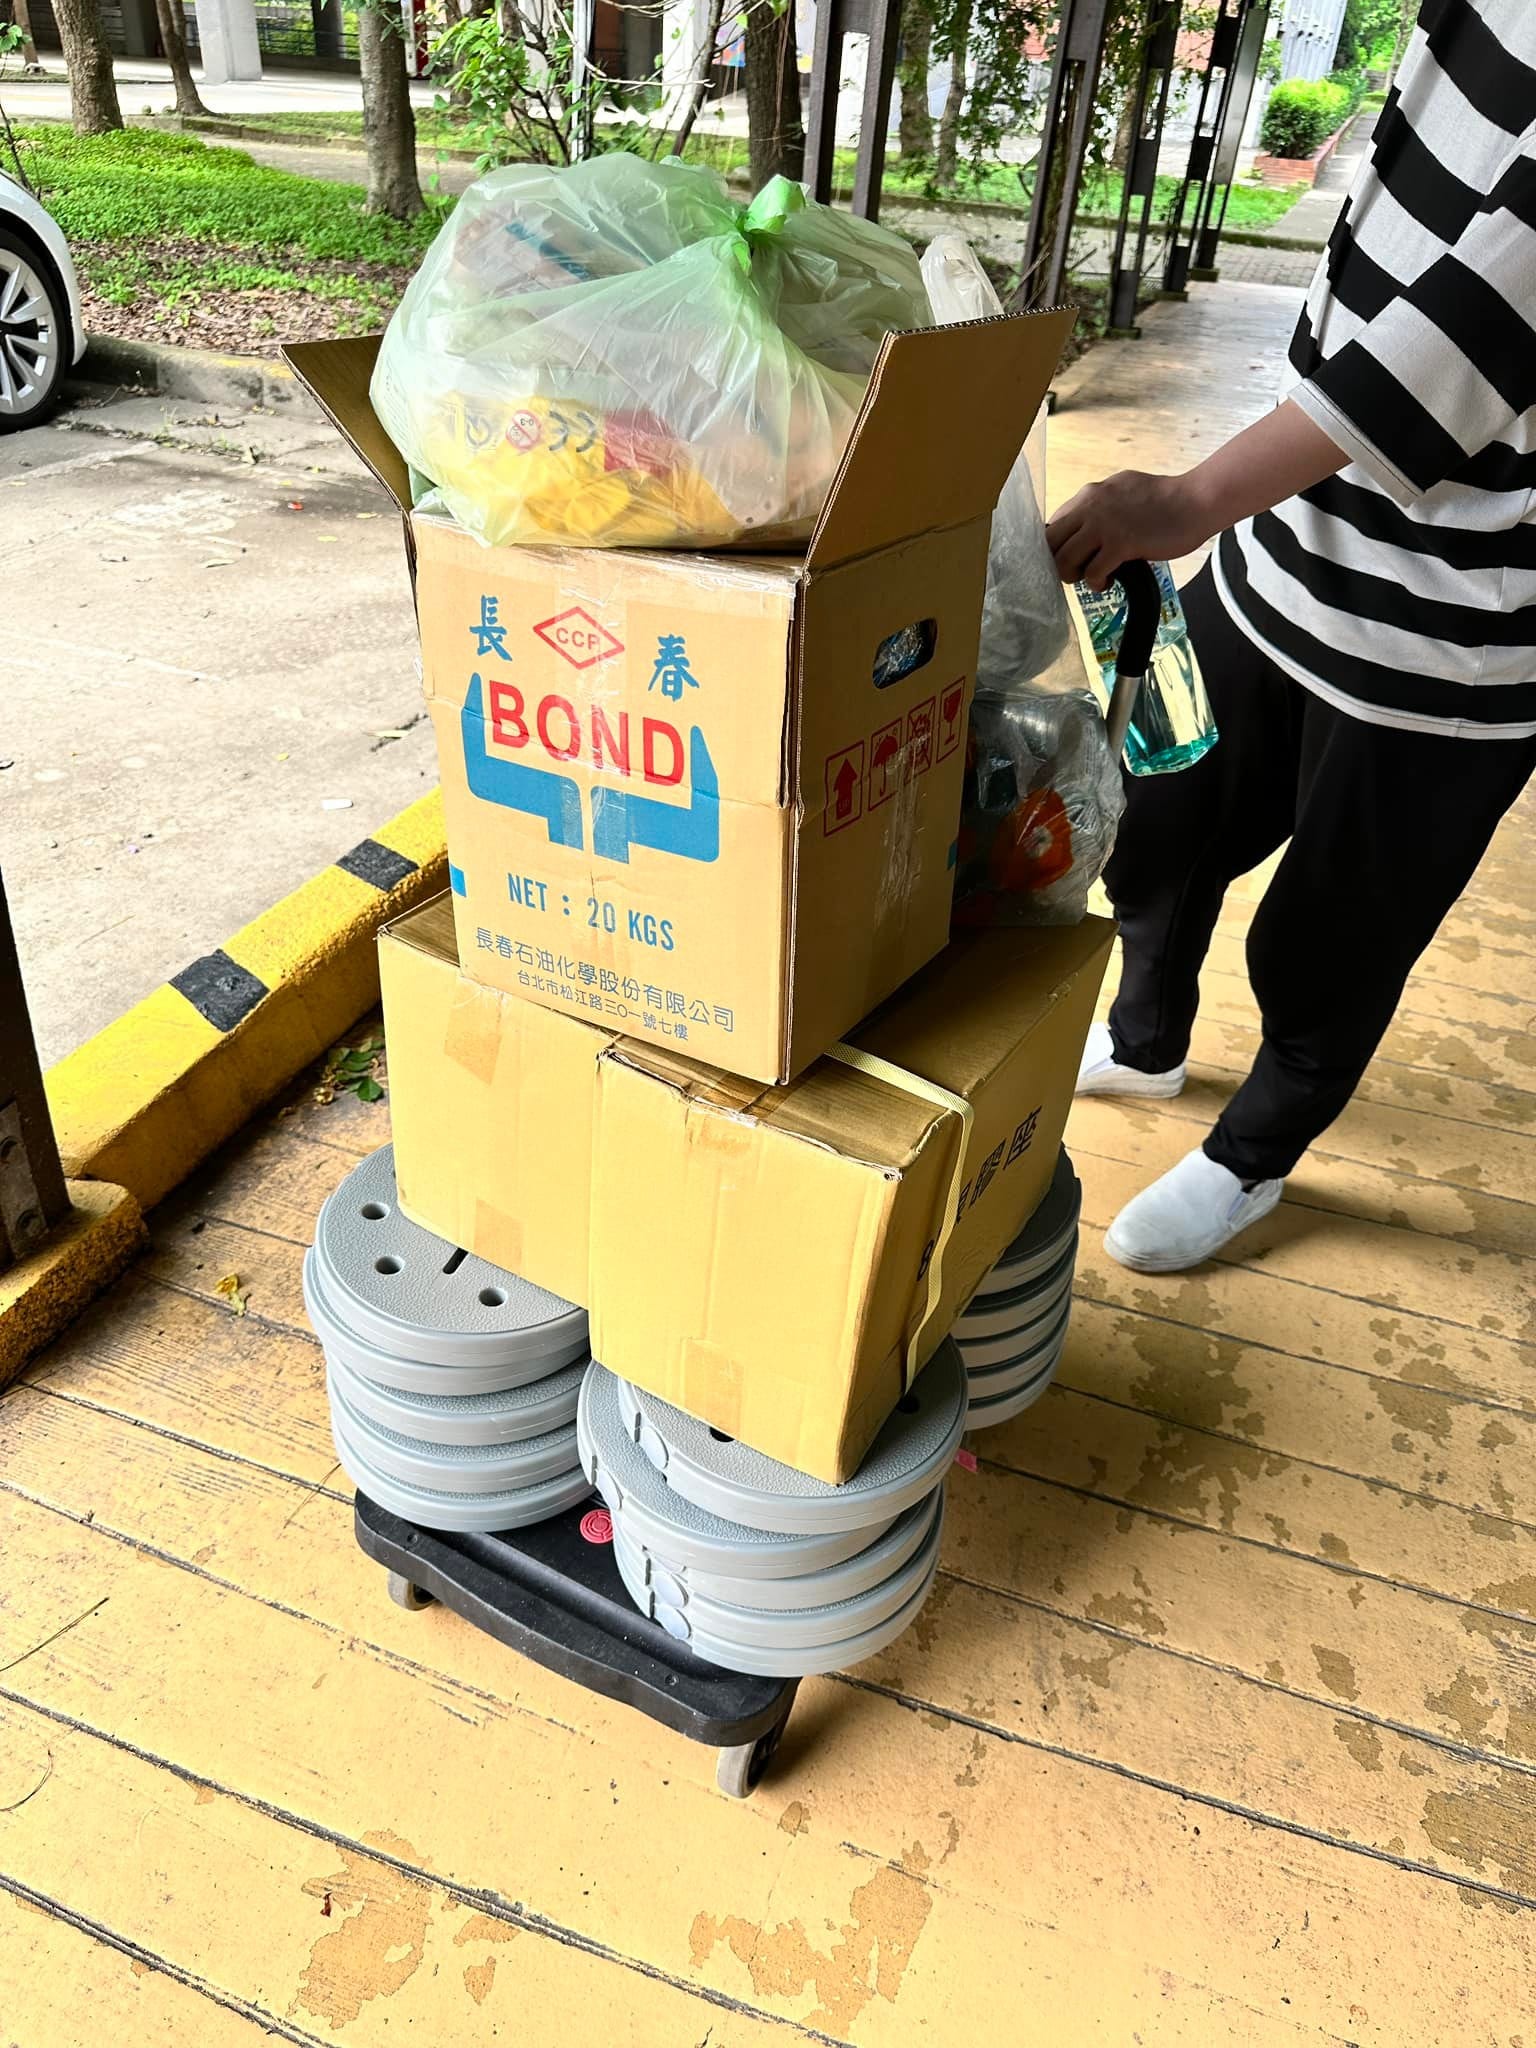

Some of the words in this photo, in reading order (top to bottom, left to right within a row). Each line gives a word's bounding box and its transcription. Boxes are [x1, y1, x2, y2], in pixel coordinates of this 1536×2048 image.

[555, 627, 600, 651] CCP
[489, 680, 684, 787] BOND
[507, 873, 547, 912] NET
[587, 897, 617, 933] 20
[628, 909, 674, 951] KGS
[475, 927, 734, 1032] 長春石油化學股份有限公司
